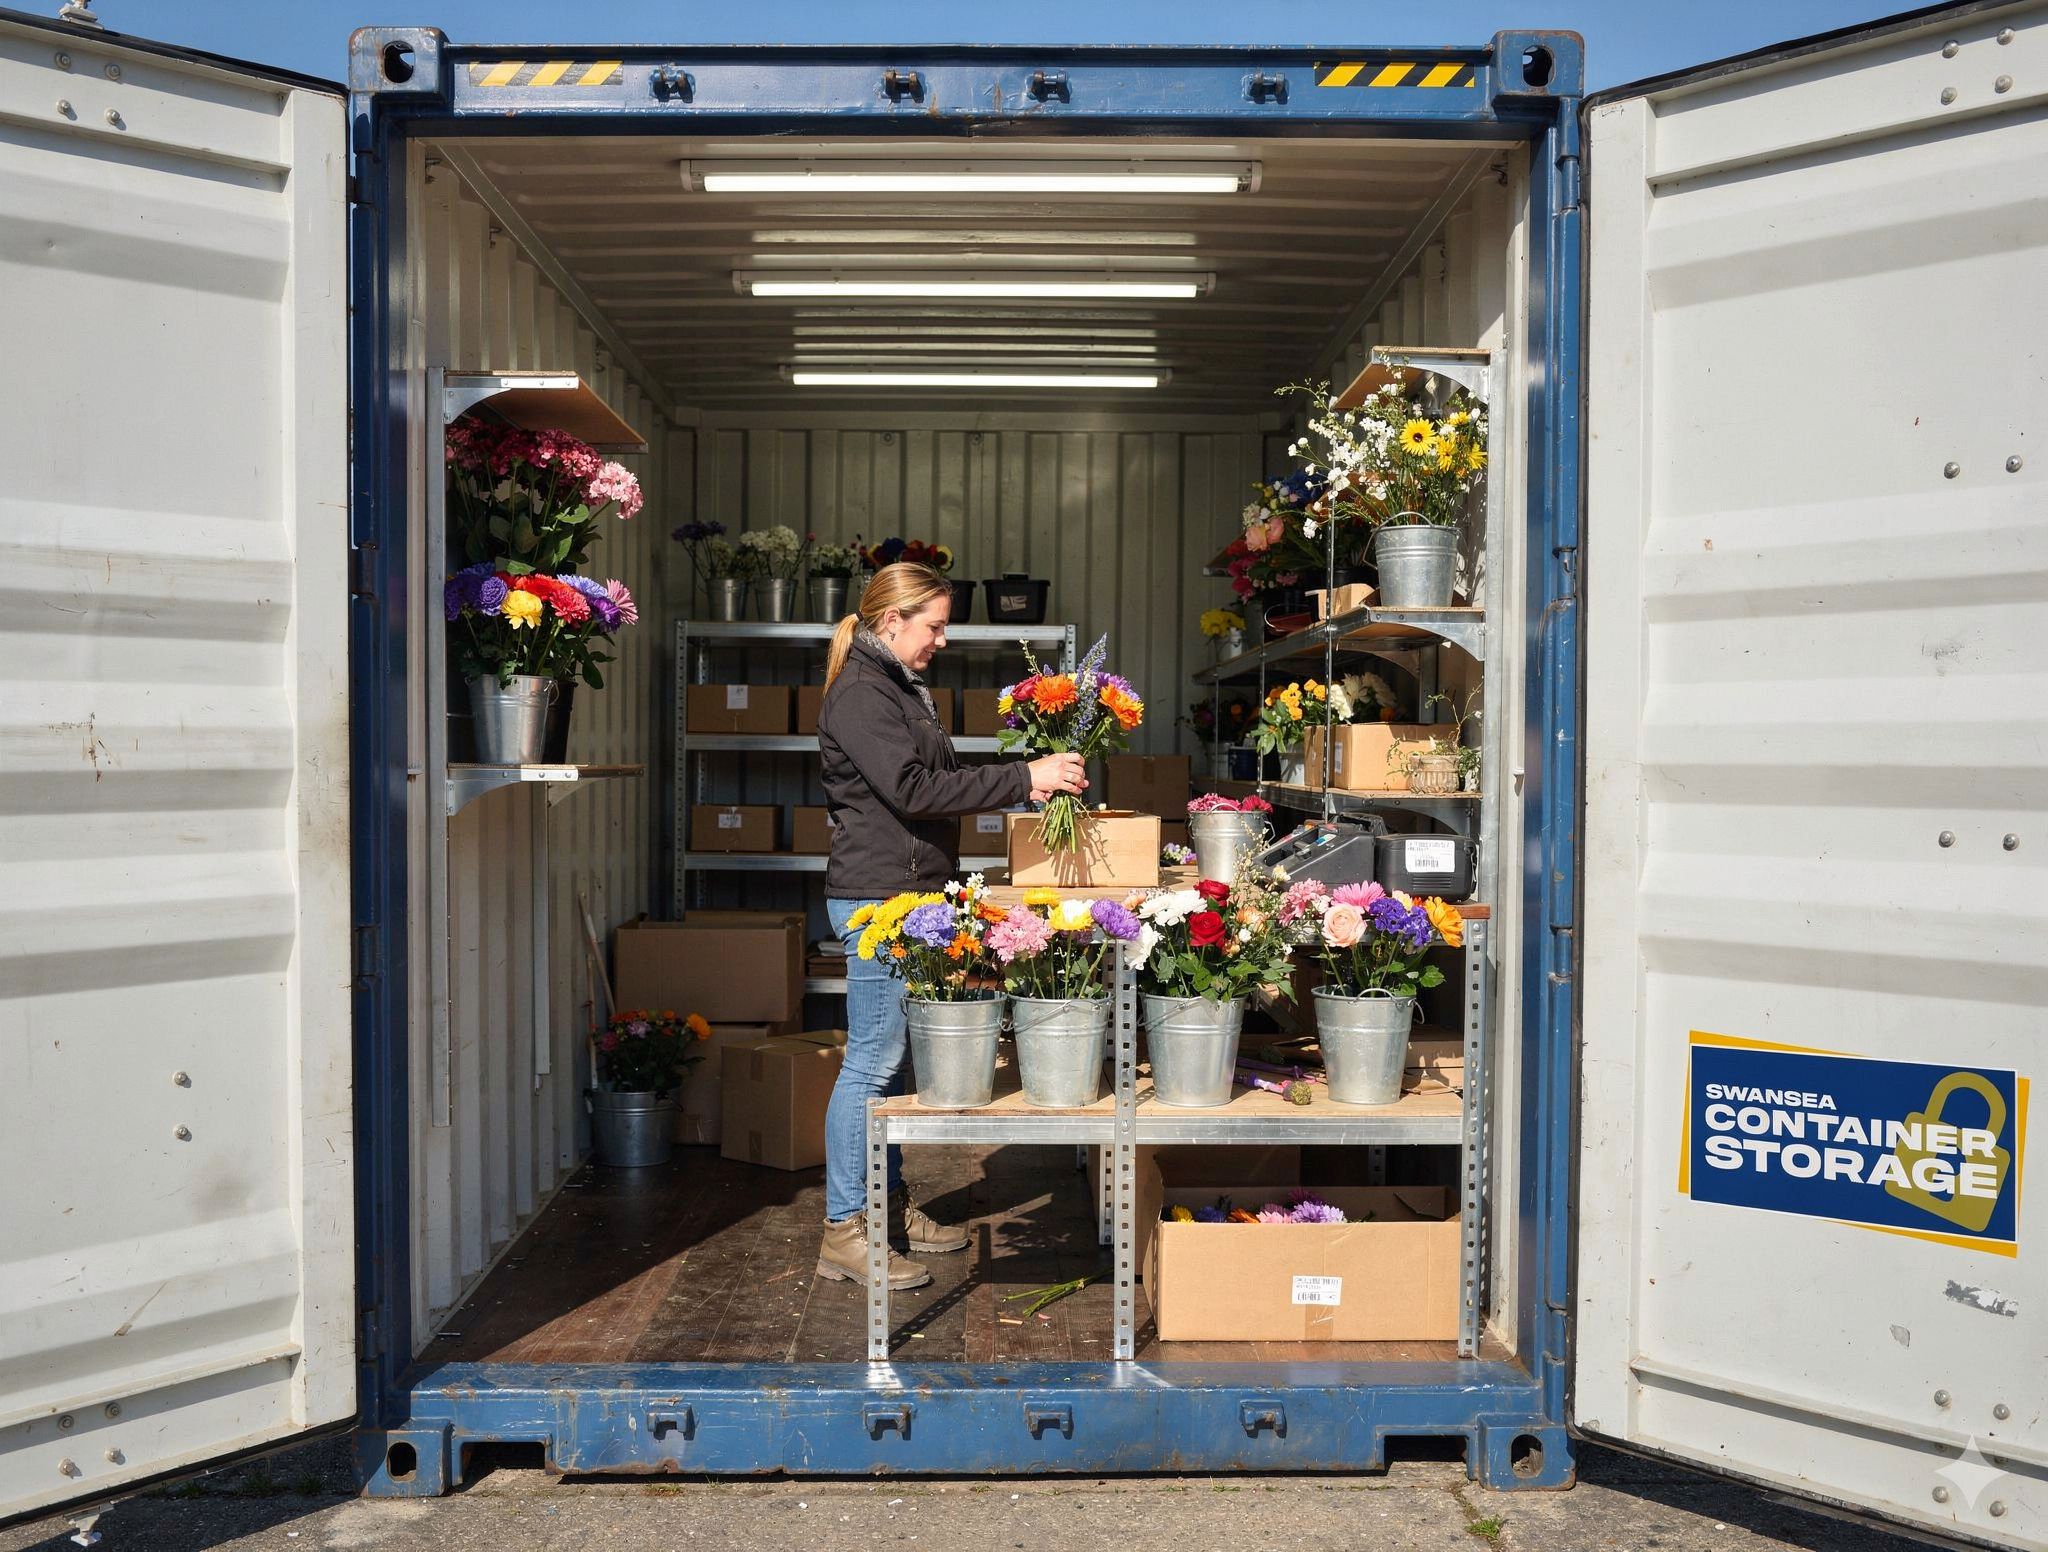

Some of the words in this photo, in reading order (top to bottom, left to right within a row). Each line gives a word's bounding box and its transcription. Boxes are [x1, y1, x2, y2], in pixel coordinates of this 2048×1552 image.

[1705, 1083, 1837, 1110] SWANSEA
[1704, 1104, 1997, 1158] CONTAINER
[1704, 1136, 1998, 1199] STORAGE
